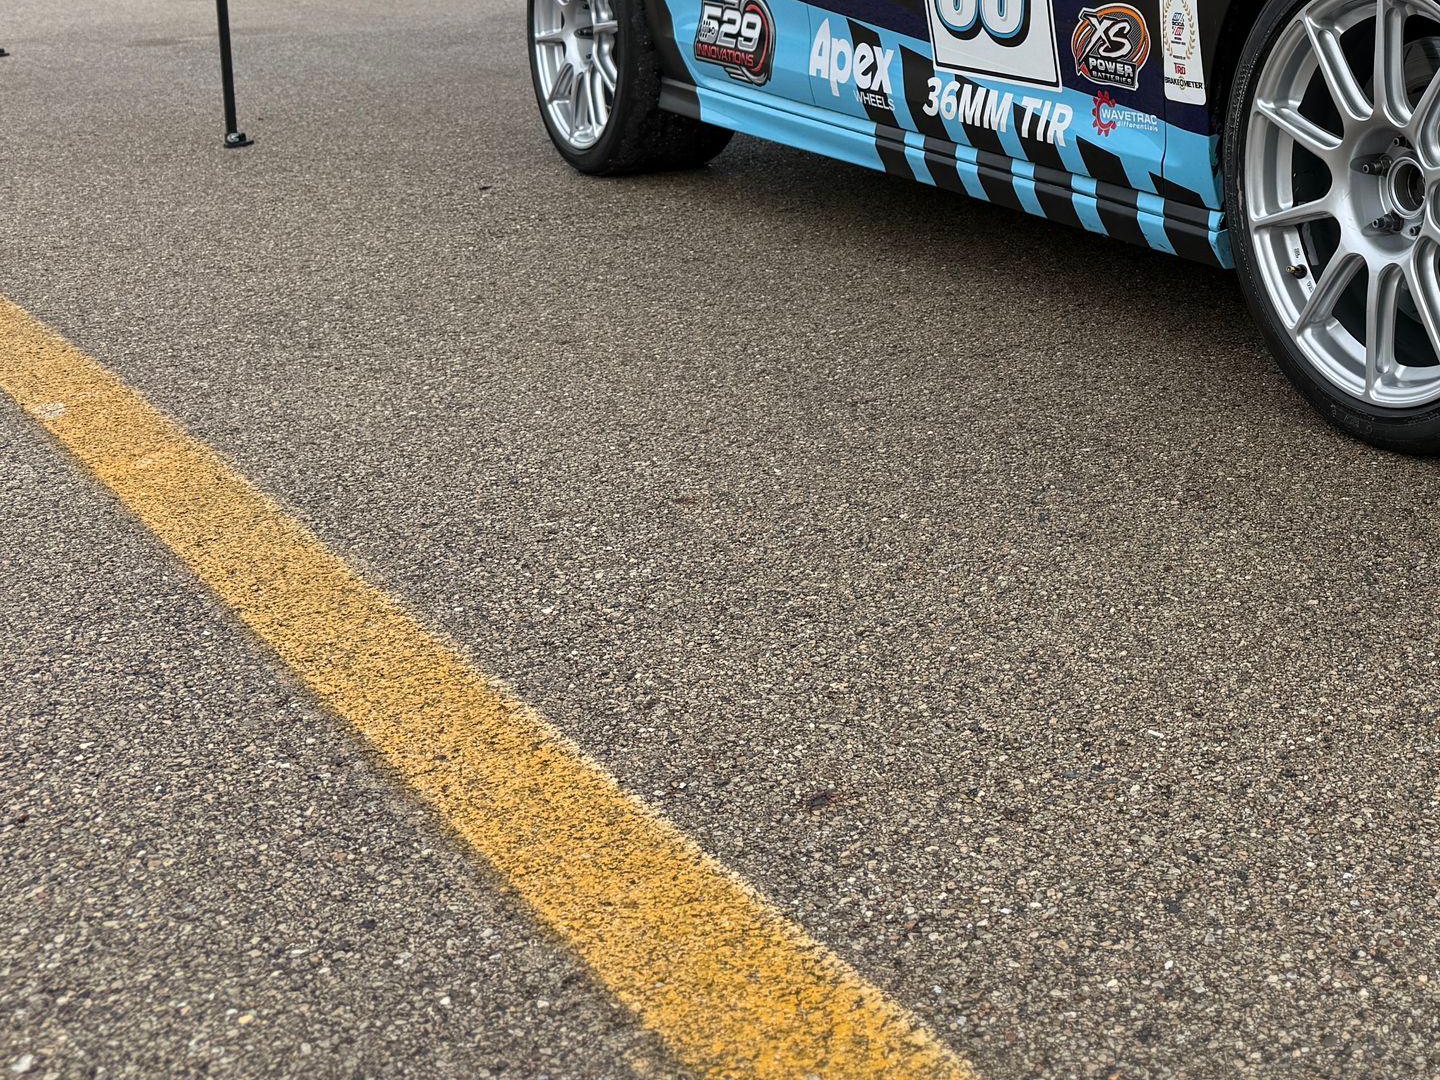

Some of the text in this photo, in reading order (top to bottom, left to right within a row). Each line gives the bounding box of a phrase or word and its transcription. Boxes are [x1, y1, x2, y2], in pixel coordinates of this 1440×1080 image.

[699, 3, 762, 52] 529
[1079, 16, 1132, 62] XS
[696, 43, 754, 67] INNOVATIONS
[809, 17, 894, 97] Apex
[1088, 57, 1134, 77] POWER
[1092, 70, 1132, 85] BATTERIES
[853, 89, 895, 111] WHEELS
[922, 77, 1073, 147] 36MM TIR
[1101, 108, 1157, 125] WAVETRAC
